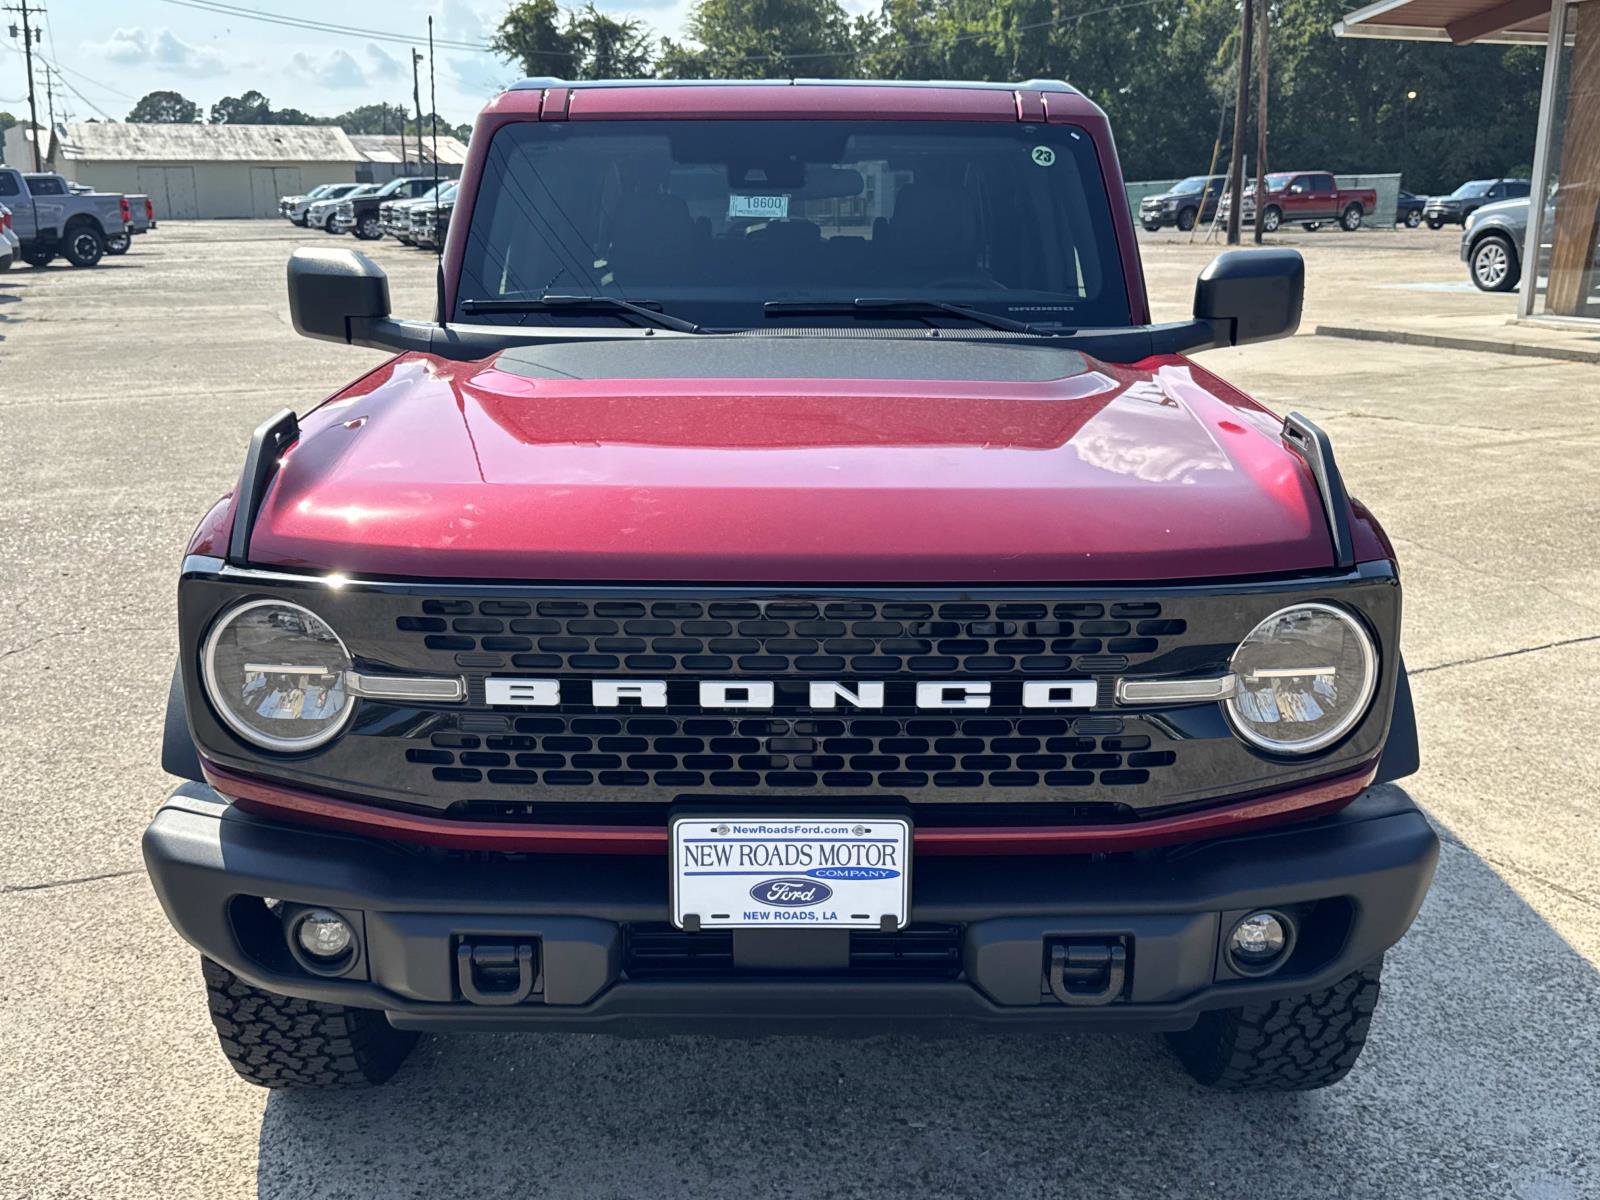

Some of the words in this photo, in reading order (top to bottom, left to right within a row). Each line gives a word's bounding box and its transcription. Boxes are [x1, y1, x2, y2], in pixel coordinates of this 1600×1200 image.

[1034, 148, 1051, 162] 23
[485, 677, 1098, 708] BRONCO
[733, 825, 848, 834] NewRoadsFord.com
[684, 845, 733, 867] NEW
[739, 844, 813, 867] ROADS
[818, 844, 896, 866] MOTOR
[767, 882, 816, 901] Ford
[743, 911, 769, 920] NEW
[774, 911, 819, 921] ROADS,
[823, 911, 838, 920] LA
